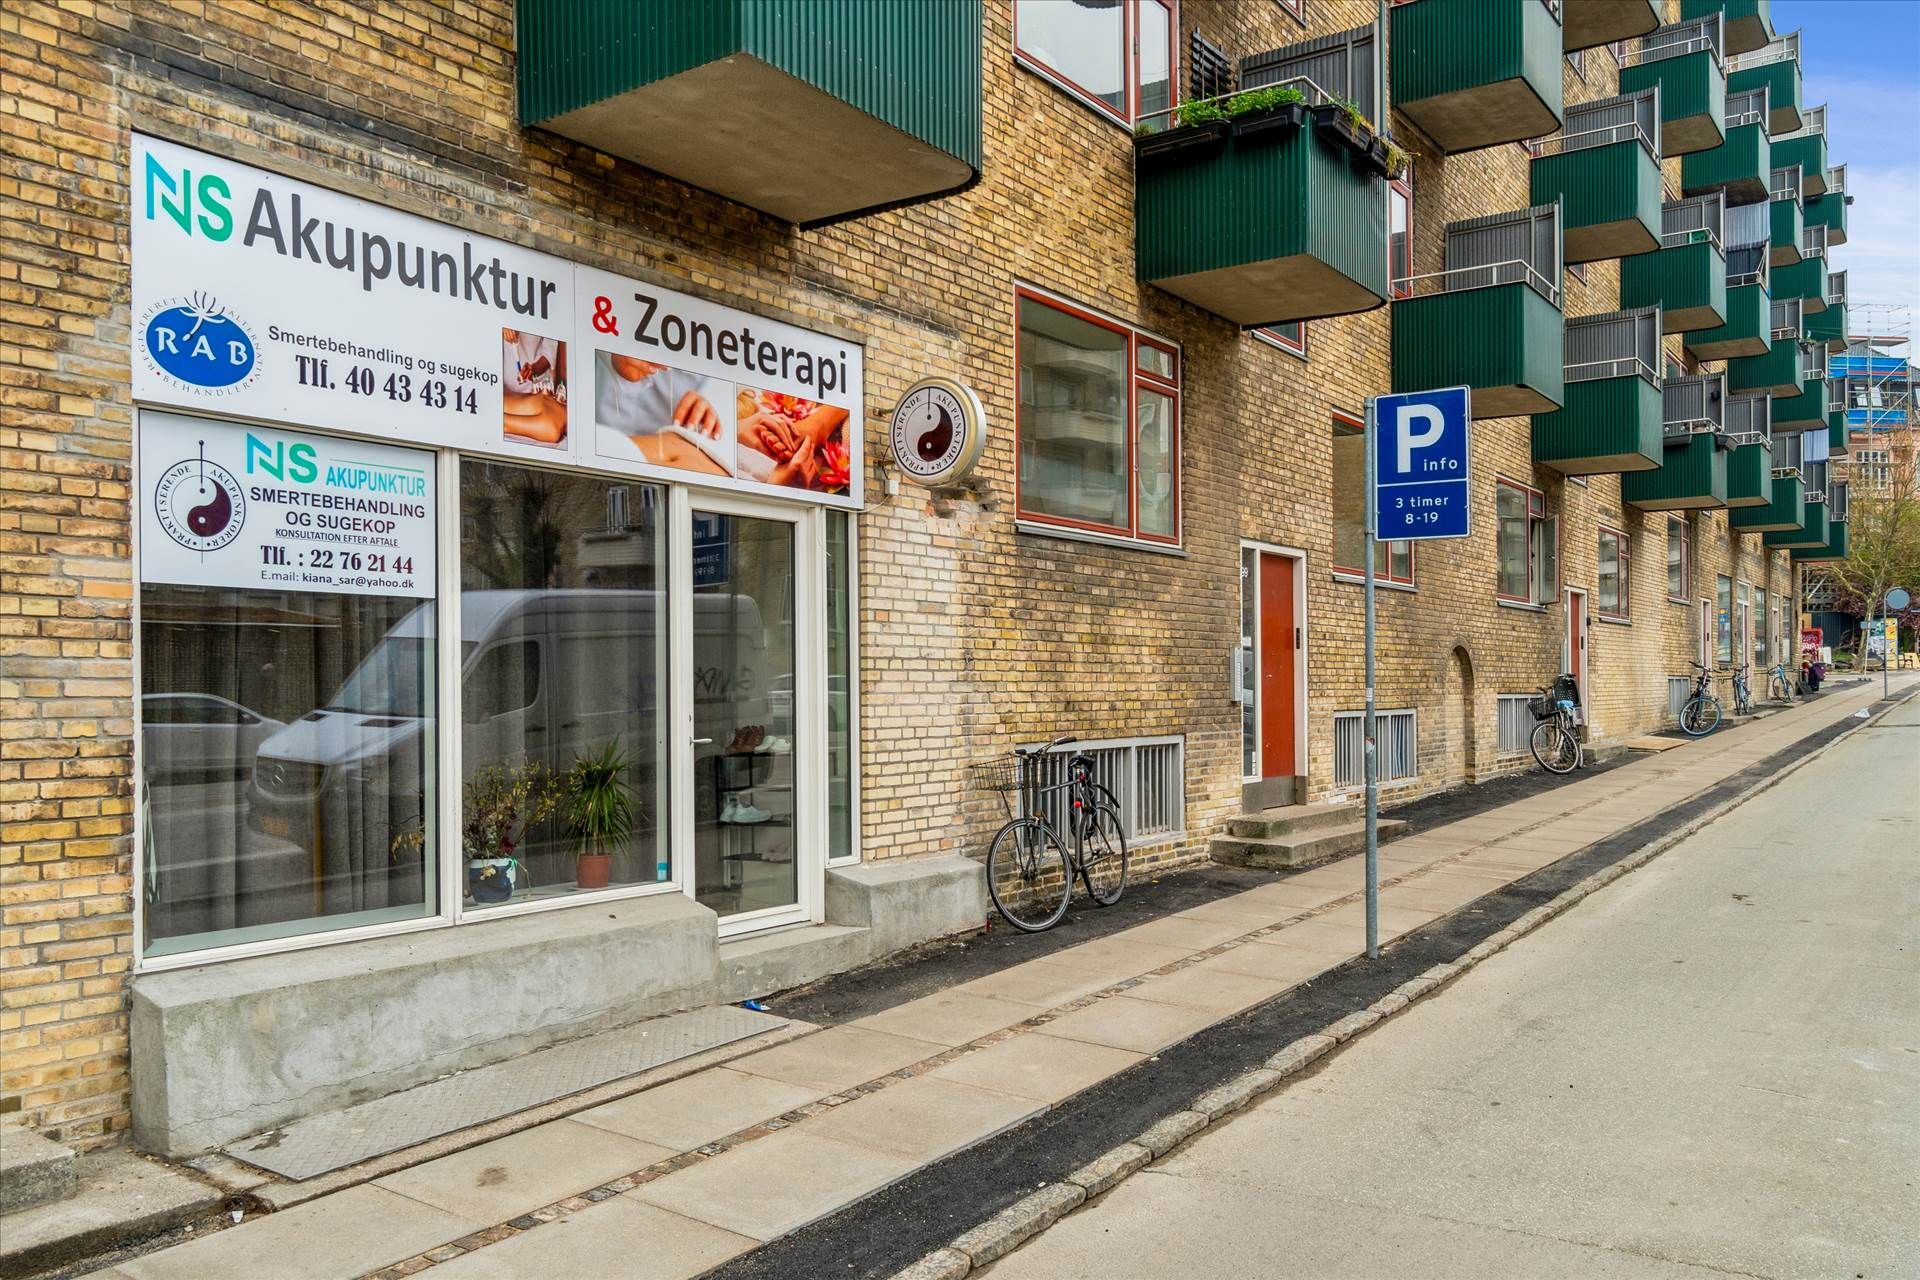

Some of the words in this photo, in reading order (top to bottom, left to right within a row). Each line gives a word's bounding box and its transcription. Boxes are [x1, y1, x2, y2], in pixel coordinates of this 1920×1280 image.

[145, 151, 233, 243] NS
[243, 188, 556, 319] Akupunktur
[592, 295, 619, 336] &
[634, 293, 847, 399] Zoneterapi
[268, 326, 413, 369] Smertebehandling
[418, 359, 435, 374] og
[440, 363, 498, 386] sugekop
[295, 354, 336, 390] Tlf.
[345, 365, 375, 396] 40
[383, 372, 412, 403] 43
[420, 379, 447, 409] 43
[454, 385, 478, 414] 14
[1397, 403, 1445, 473] P
[247, 432, 318, 483] NS
[326, 466, 426, 497] AKUPUNKTUR
[1424, 457, 1458, 471] info
[250, 487, 425, 518] SMERTEBEHANDLING
[1395, 498, 1403, 508] 3
[1410, 496, 1449, 508] timer
[286, 511, 311, 527] OG
[317, 514, 395, 534] SUGEKOP
[1405, 512, 1439, 524] 8-19
[275, 528, 341, 542] KONSULTATION
[343, 535, 368, 544] EFTER
[370, 537, 398, 547] AFTALE
[261, 545, 291, 566] Tlf.
[310, 550, 334, 568] 22
[340, 551, 362, 570] 76
[368, 554, 386, 572] 21
[392, 556, 413, 574] 44
[261, 571, 299, 582] E.mail:
[302, 573, 414, 588] kiana_sar@yahoo.dk
